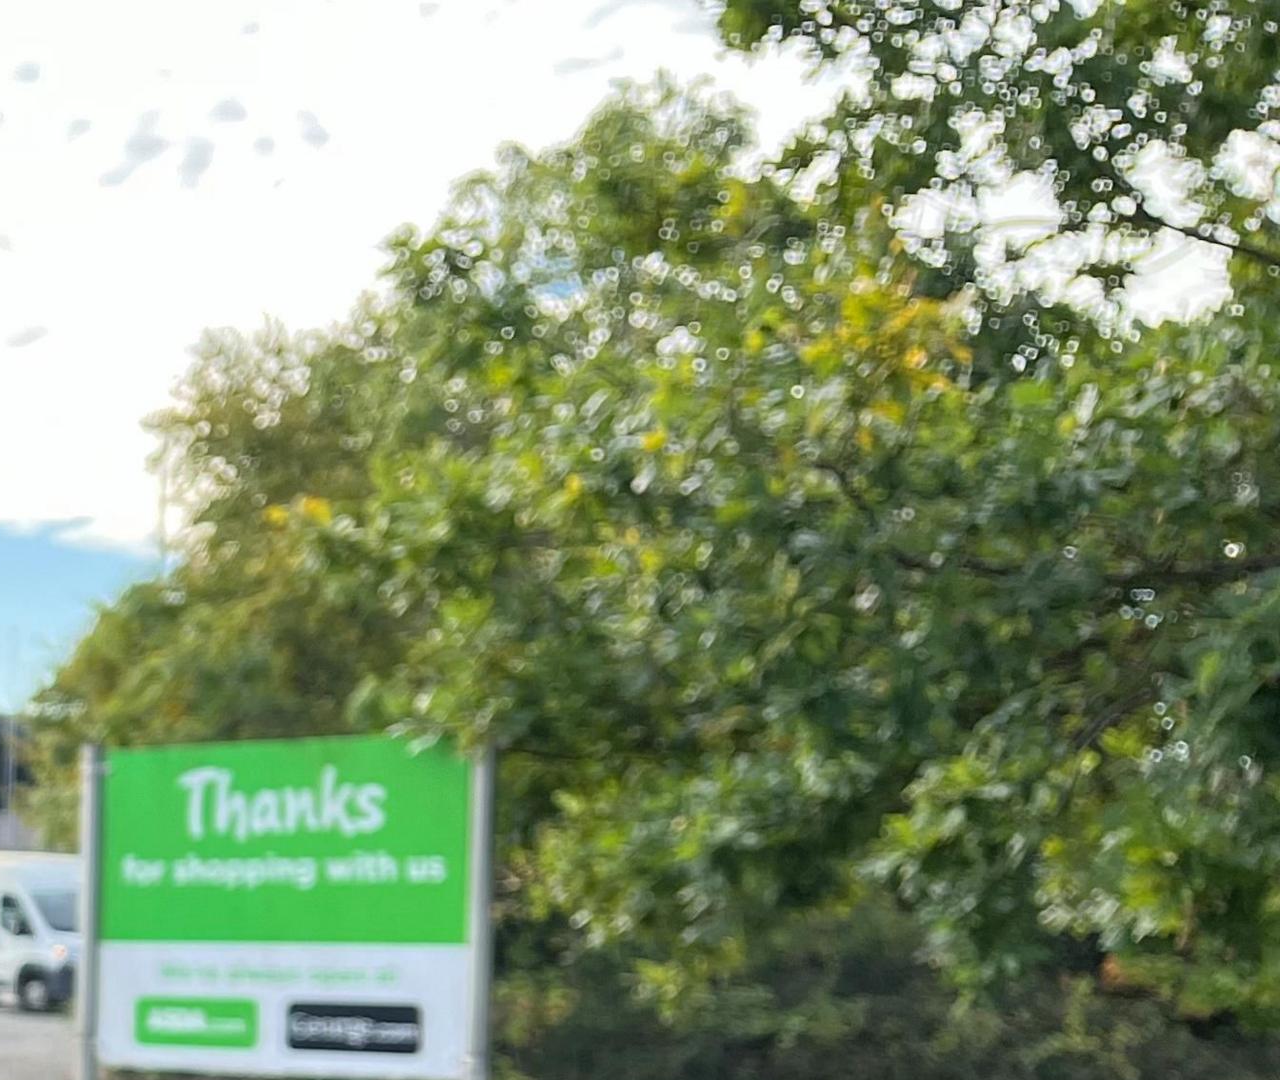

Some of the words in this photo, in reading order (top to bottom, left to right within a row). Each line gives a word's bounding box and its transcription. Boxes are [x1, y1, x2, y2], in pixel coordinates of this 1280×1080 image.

[178, 764, 386, 841] Thanks
[121, 853, 165, 885] for
[172, 852, 316, 889] shopping
[326, 850, 397, 882] with
[407, 855, 446, 884] us
